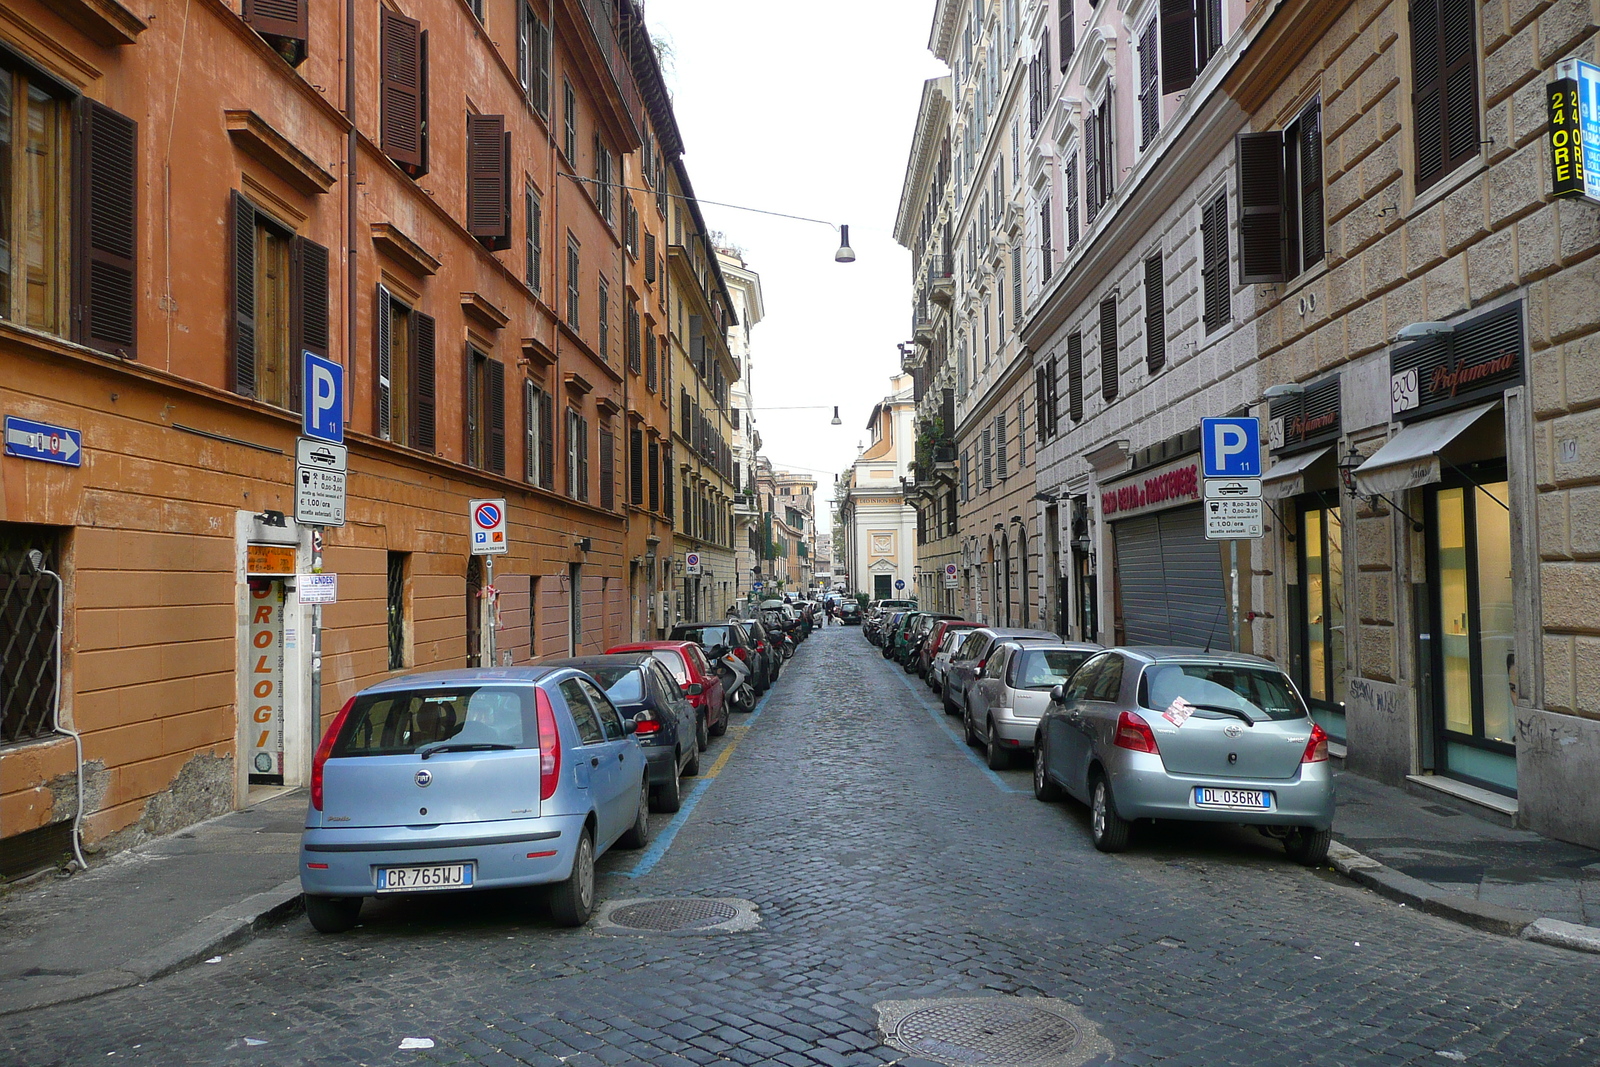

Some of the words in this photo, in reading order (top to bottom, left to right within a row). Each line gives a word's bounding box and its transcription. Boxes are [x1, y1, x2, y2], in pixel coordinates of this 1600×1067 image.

[1552, 130, 1570, 182] ORE
[1572, 128, 1583, 180] ORE
[312, 363, 336, 430] P
[1393, 368, 1418, 411] ego
[1429, 349, 1516, 397] Profumeria
[1213, 423, 1248, 471] P
[1240, 462, 1250, 471] 11
[1204, 789, 1219, 803] DL
[1224, 790, 1261, 806] 036RK
[388, 870, 406, 886] CR
[412, 867, 462, 885] 765WJ
